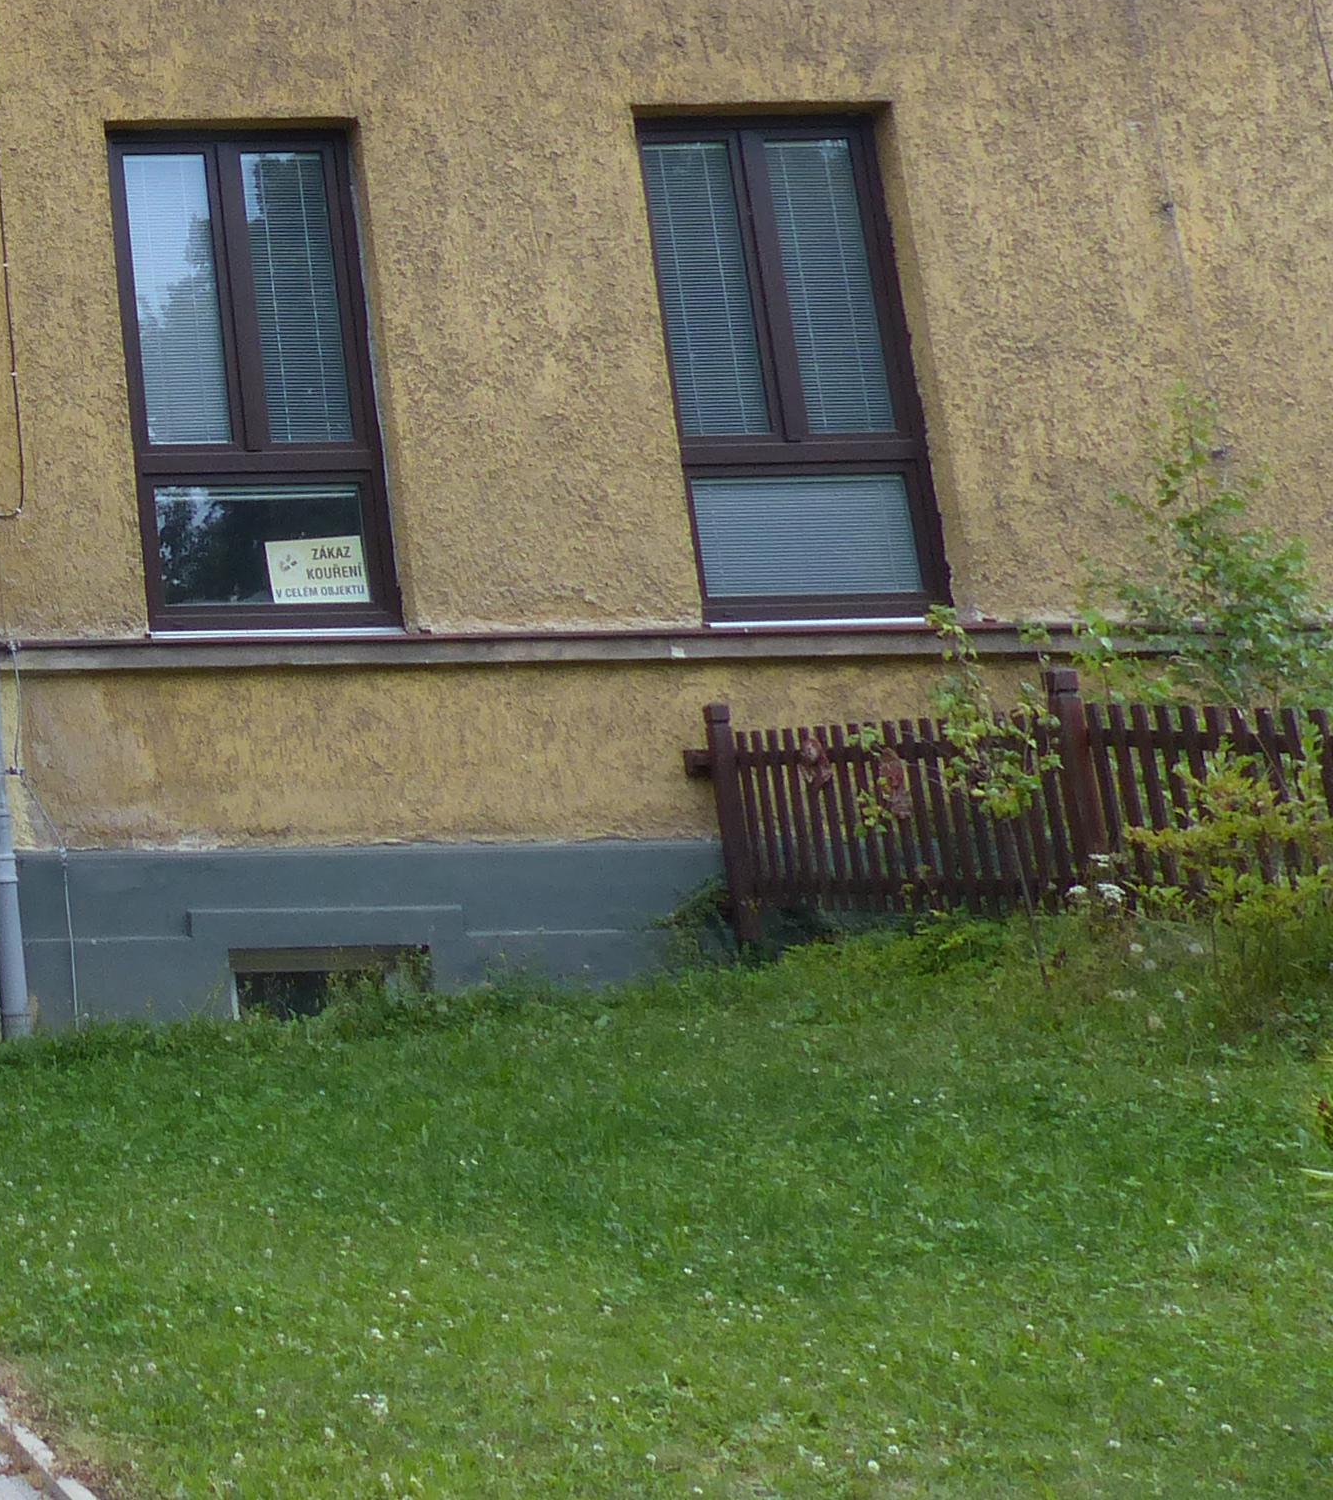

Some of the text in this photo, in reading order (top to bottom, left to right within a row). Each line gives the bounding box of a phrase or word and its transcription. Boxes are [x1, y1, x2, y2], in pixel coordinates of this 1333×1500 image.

[311, 545, 351, 560] ZÁKAZ
[306, 562, 362, 579] KOUŘENÍ
[276, 584, 365, 598] V CELÉM OBJEKTU
